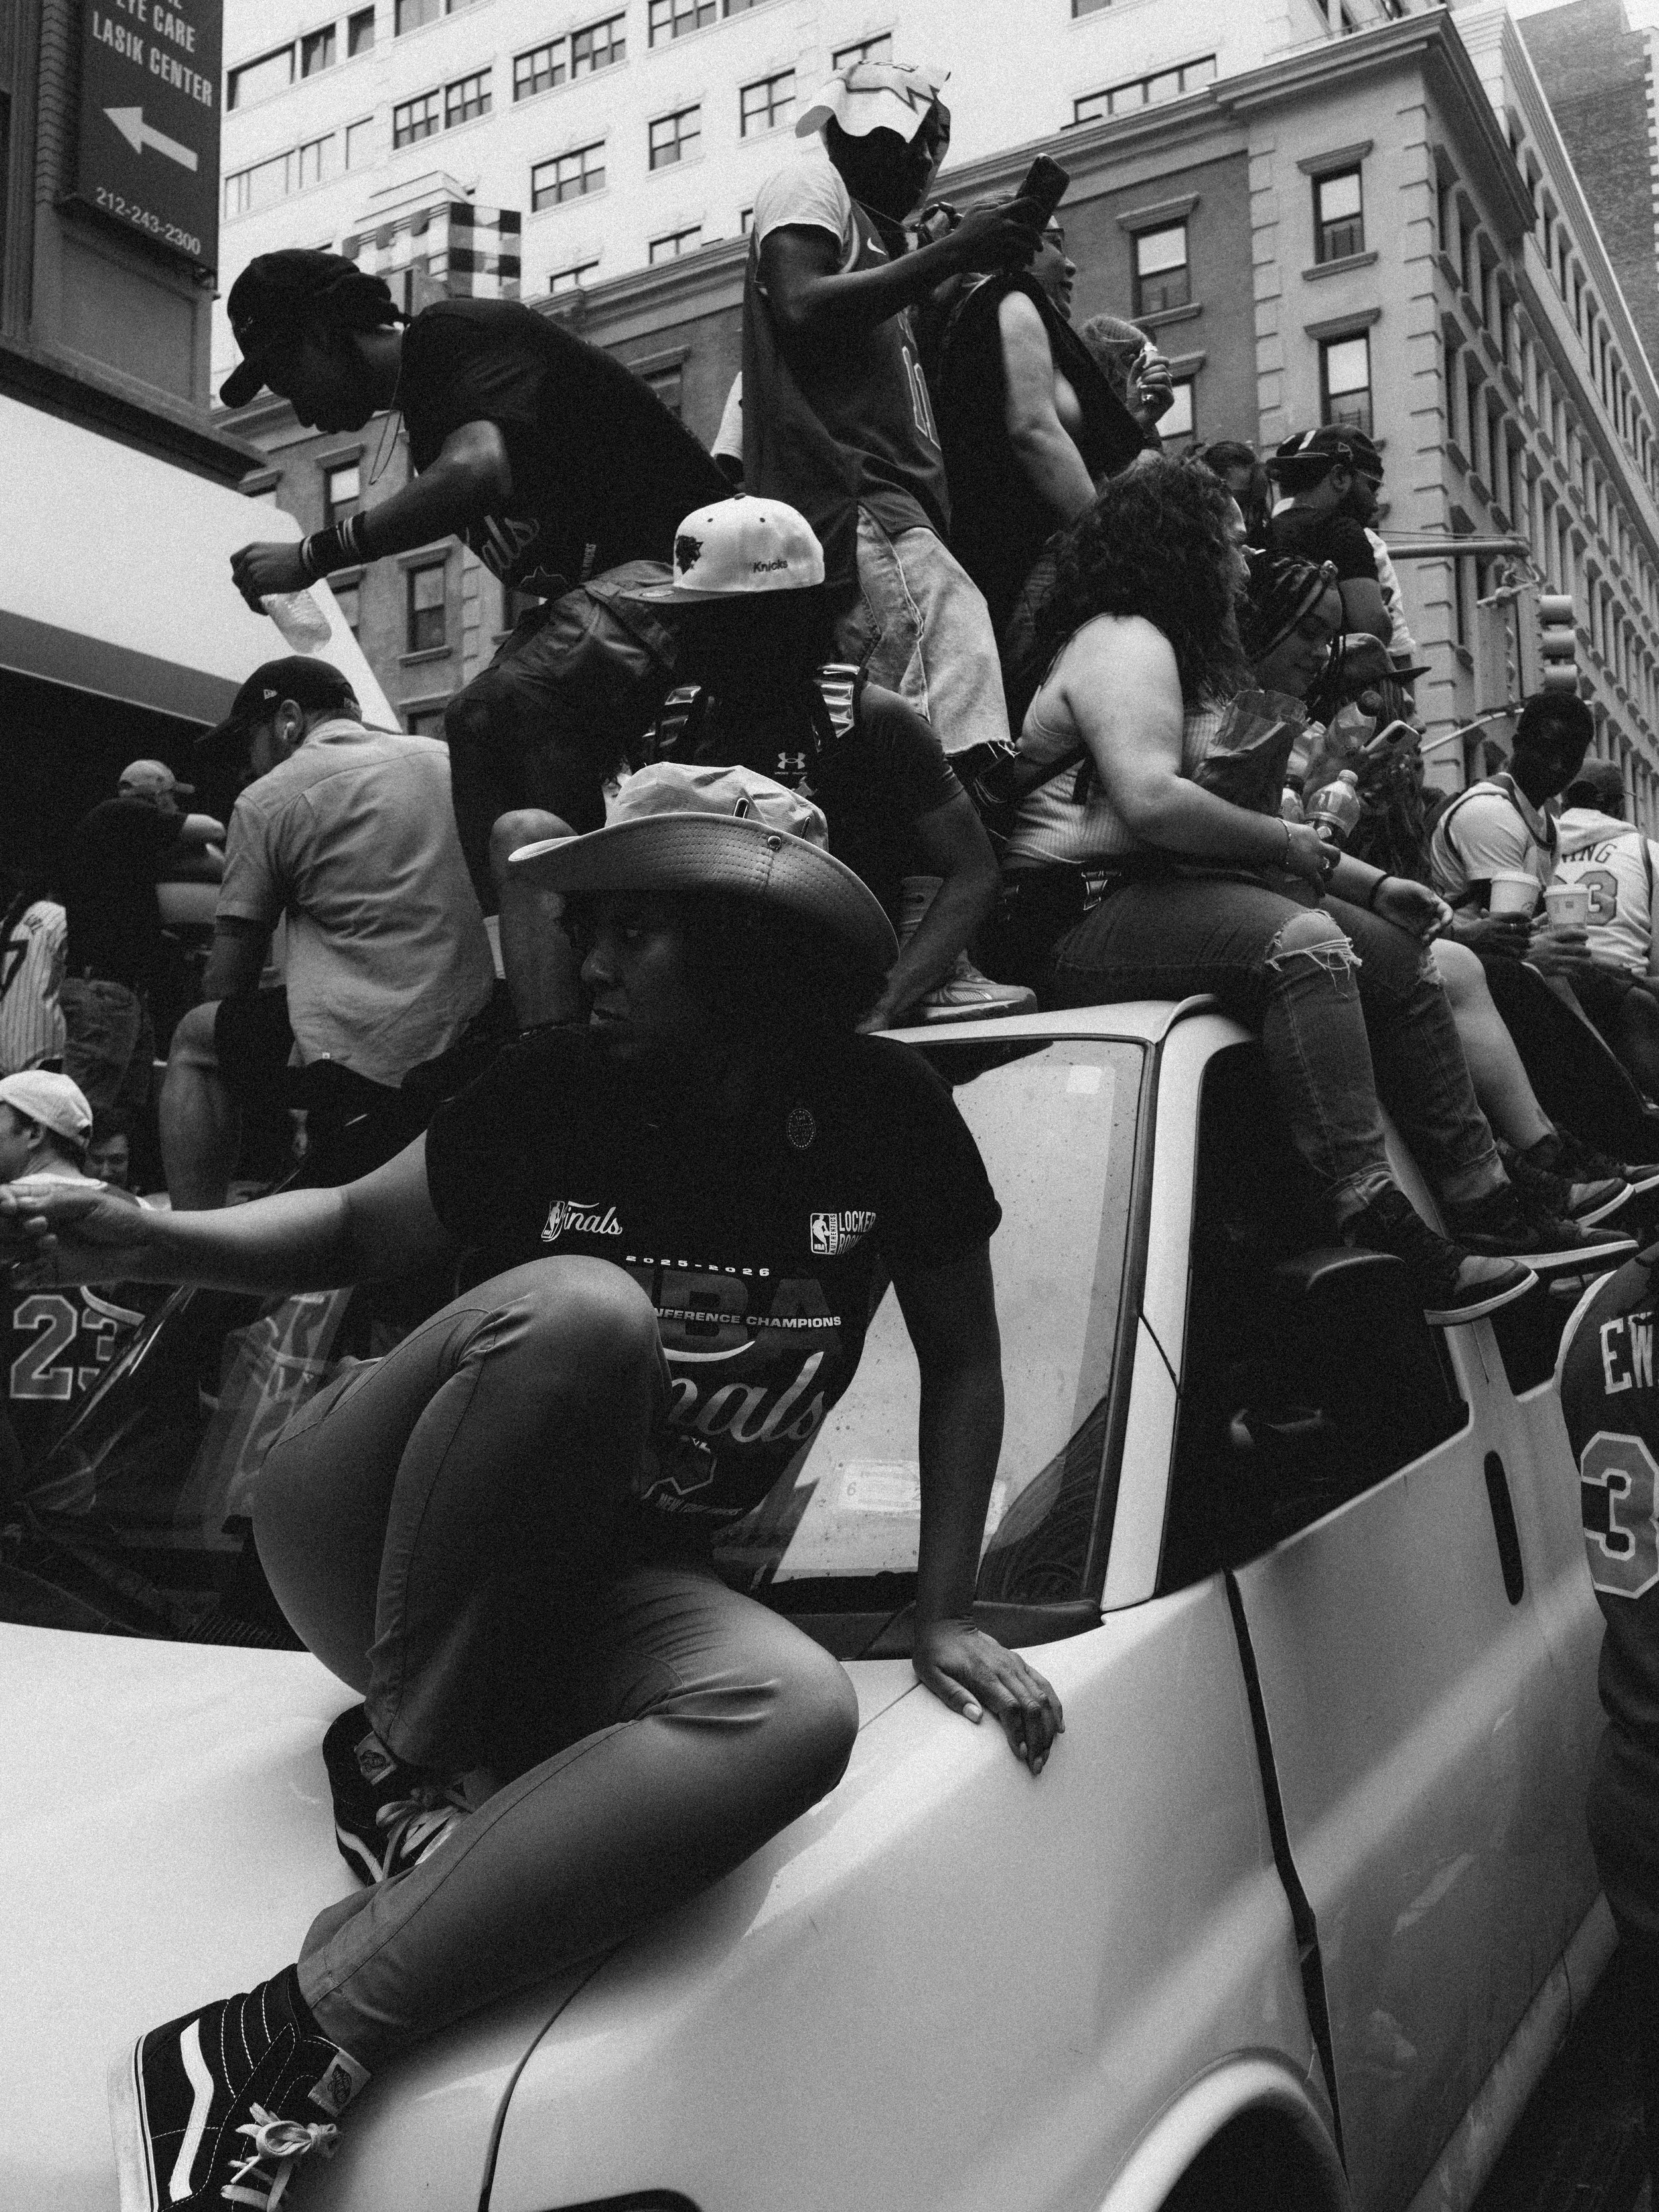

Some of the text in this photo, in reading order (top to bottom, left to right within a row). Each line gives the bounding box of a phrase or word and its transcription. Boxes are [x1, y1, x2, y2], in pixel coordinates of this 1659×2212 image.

[153, 5, 196, 53] CARE
[93, 11, 212, 107] LASIK CENTER
[96, 186, 201, 256] 212-243-2300
[753, 559, 788, 573] Knicks
[1554, 869, 1618, 926] 3
[838, 1211, 877, 1232] LOCKER
[626, 1255, 771, 1278] 2025-2026
[654, 1307, 841, 1329] NFERENCE CHAMPIONS
[662, 1340, 825, 1444] nals
